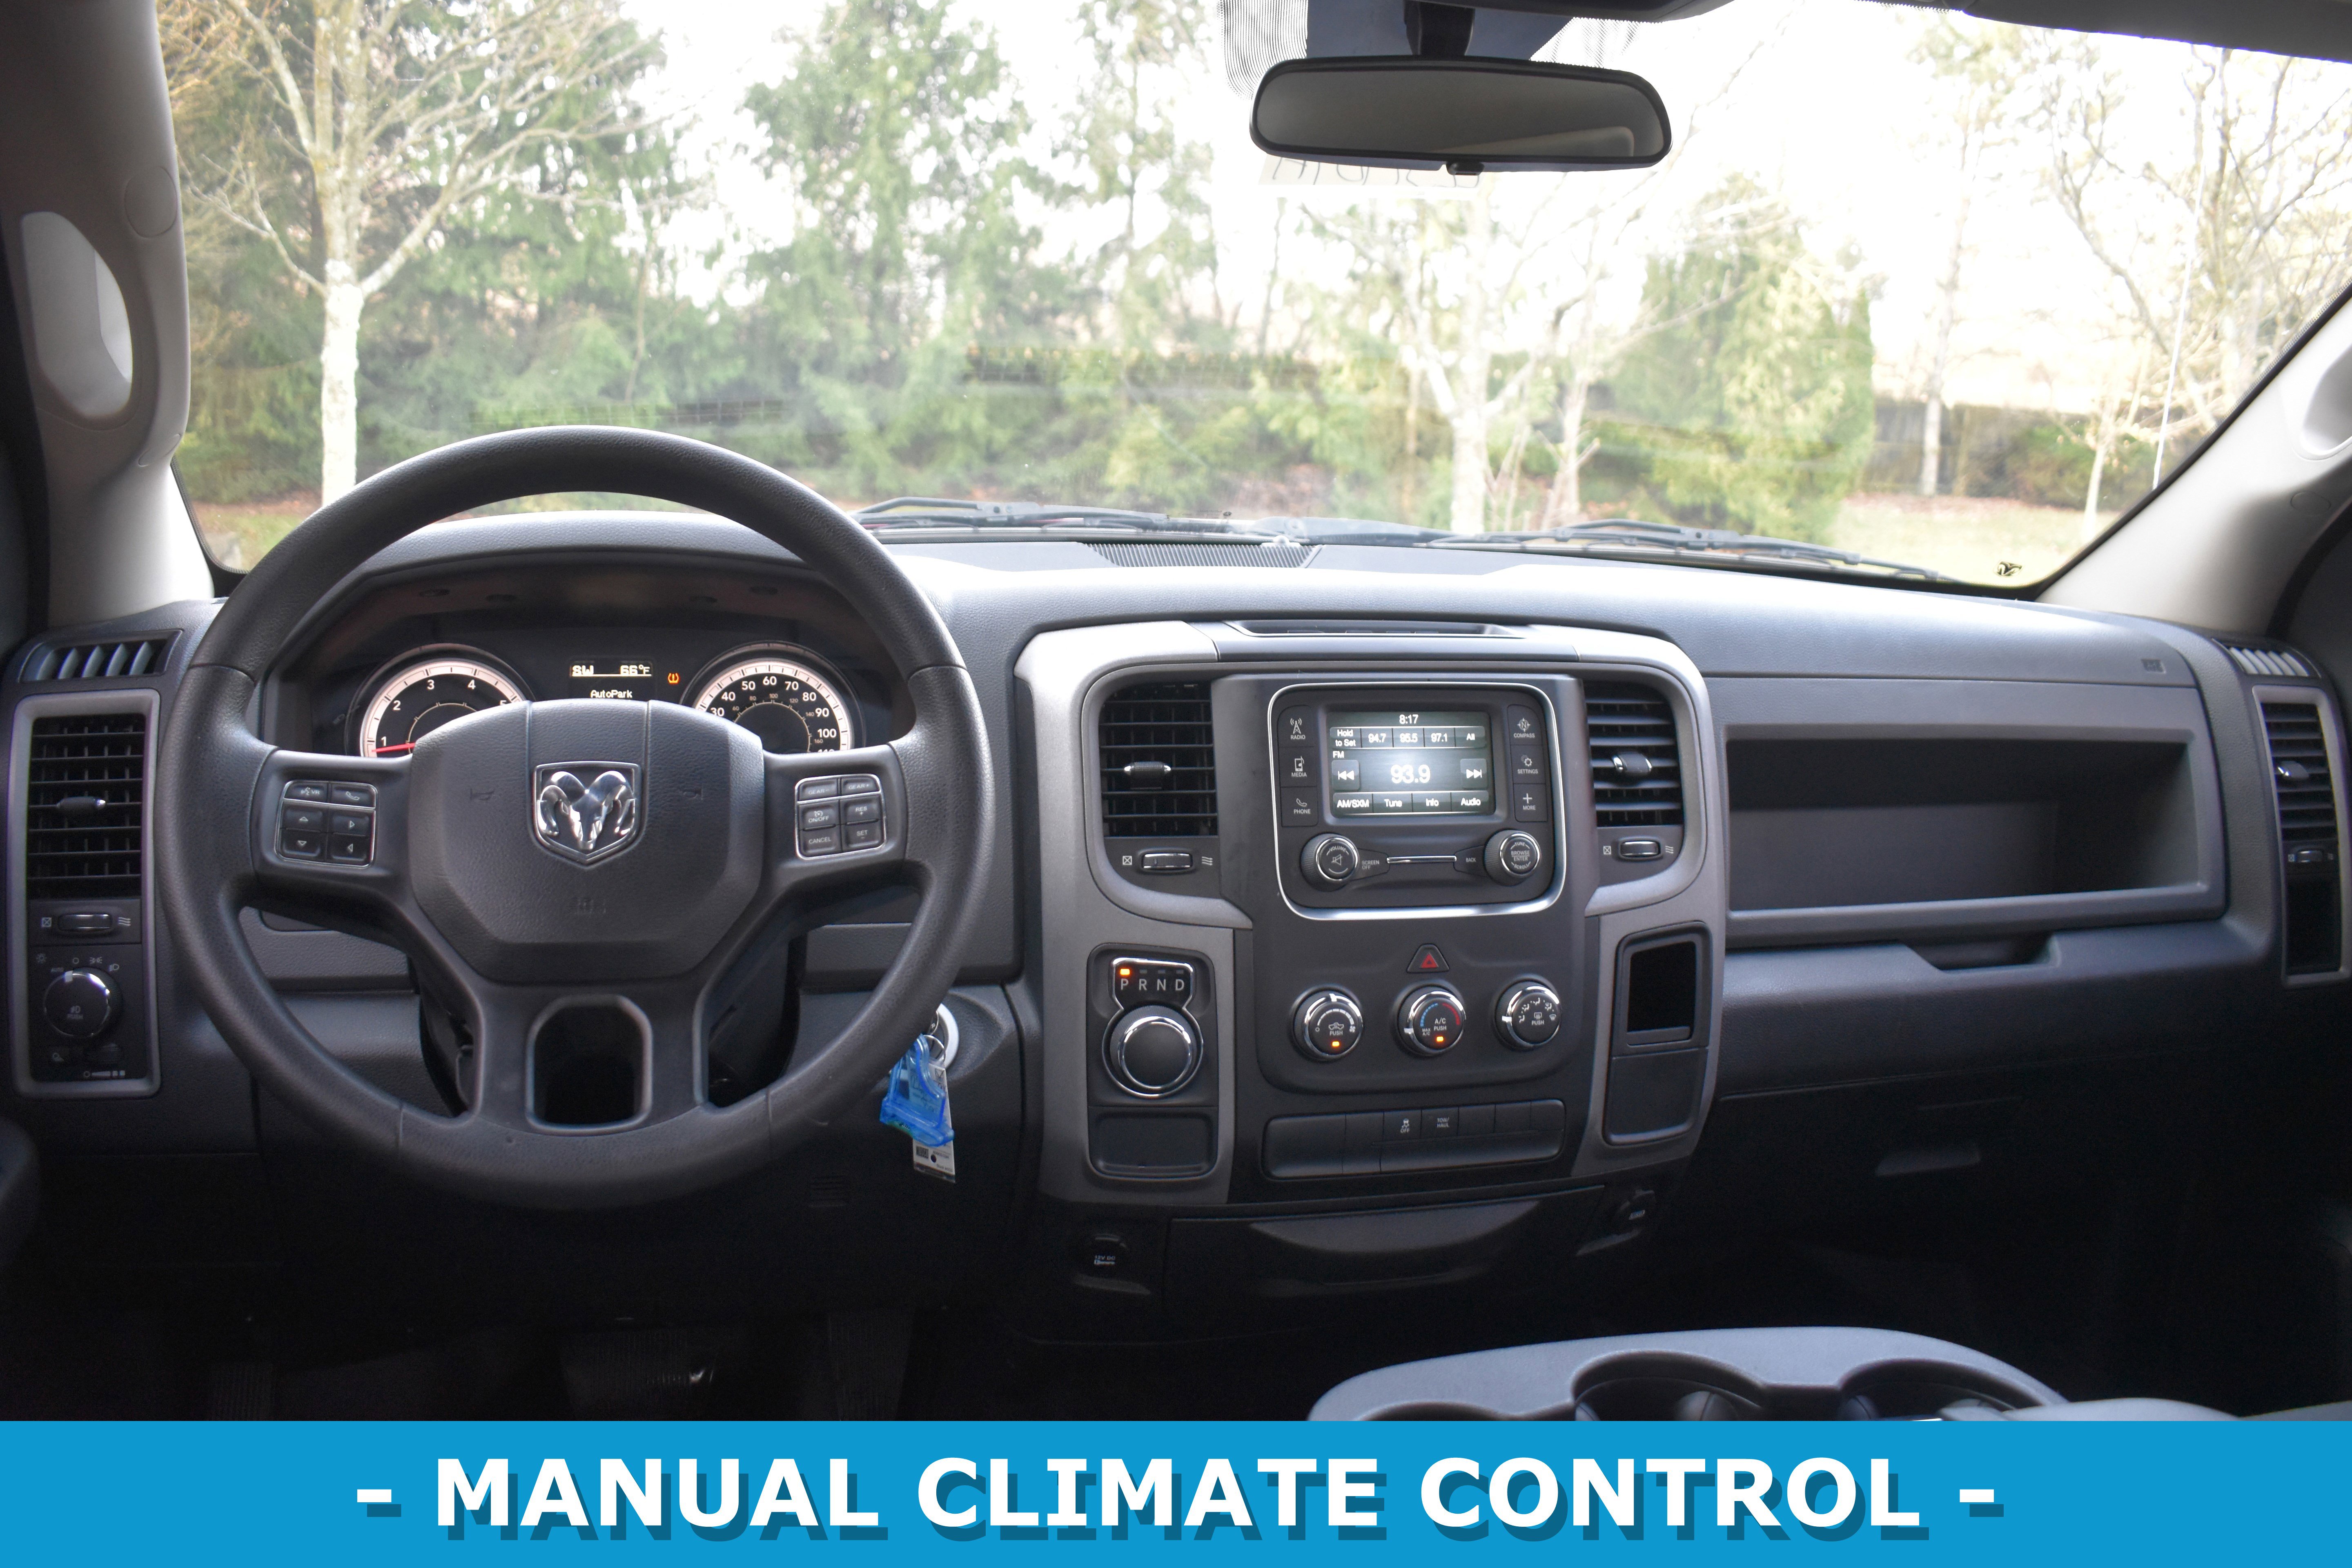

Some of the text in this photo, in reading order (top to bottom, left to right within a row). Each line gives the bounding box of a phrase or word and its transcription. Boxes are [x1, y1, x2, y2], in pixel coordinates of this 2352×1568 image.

[572, 665, 594, 675] SW
[427, 679, 435, 690] 3
[468, 679, 476, 690] 4
[742, 681, 756, 691] 50
[762, 676, 777, 686] 60
[784, 681, 799, 691] 70
[590, 689, 633, 698] AutoPark
[721, 691, 736, 701] 40
[802, 692, 817, 702] 80
[393, 700, 401, 711] 2
[710, 707, 725, 717] 30
[815, 707, 829, 718] 90
[1399, 714, 1419, 724] 8:17
[817, 728, 837, 738] 100
[1368, 733, 1386, 743] 94.7
[1399, 733, 1418, 743] 95.5
[1431, 733, 1448, 742] 97.1
[381, 736, 387, 746] 1
[1390, 764, 1431, 784] 93.9
[1337, 799, 1369, 808] AM/SXM
[1384, 799, 1402, 807] Tune
[1425, 798, 1439, 807] Info
[1461, 797, 1481, 806] Audio
[1120, 978, 1184, 991] P R N D
